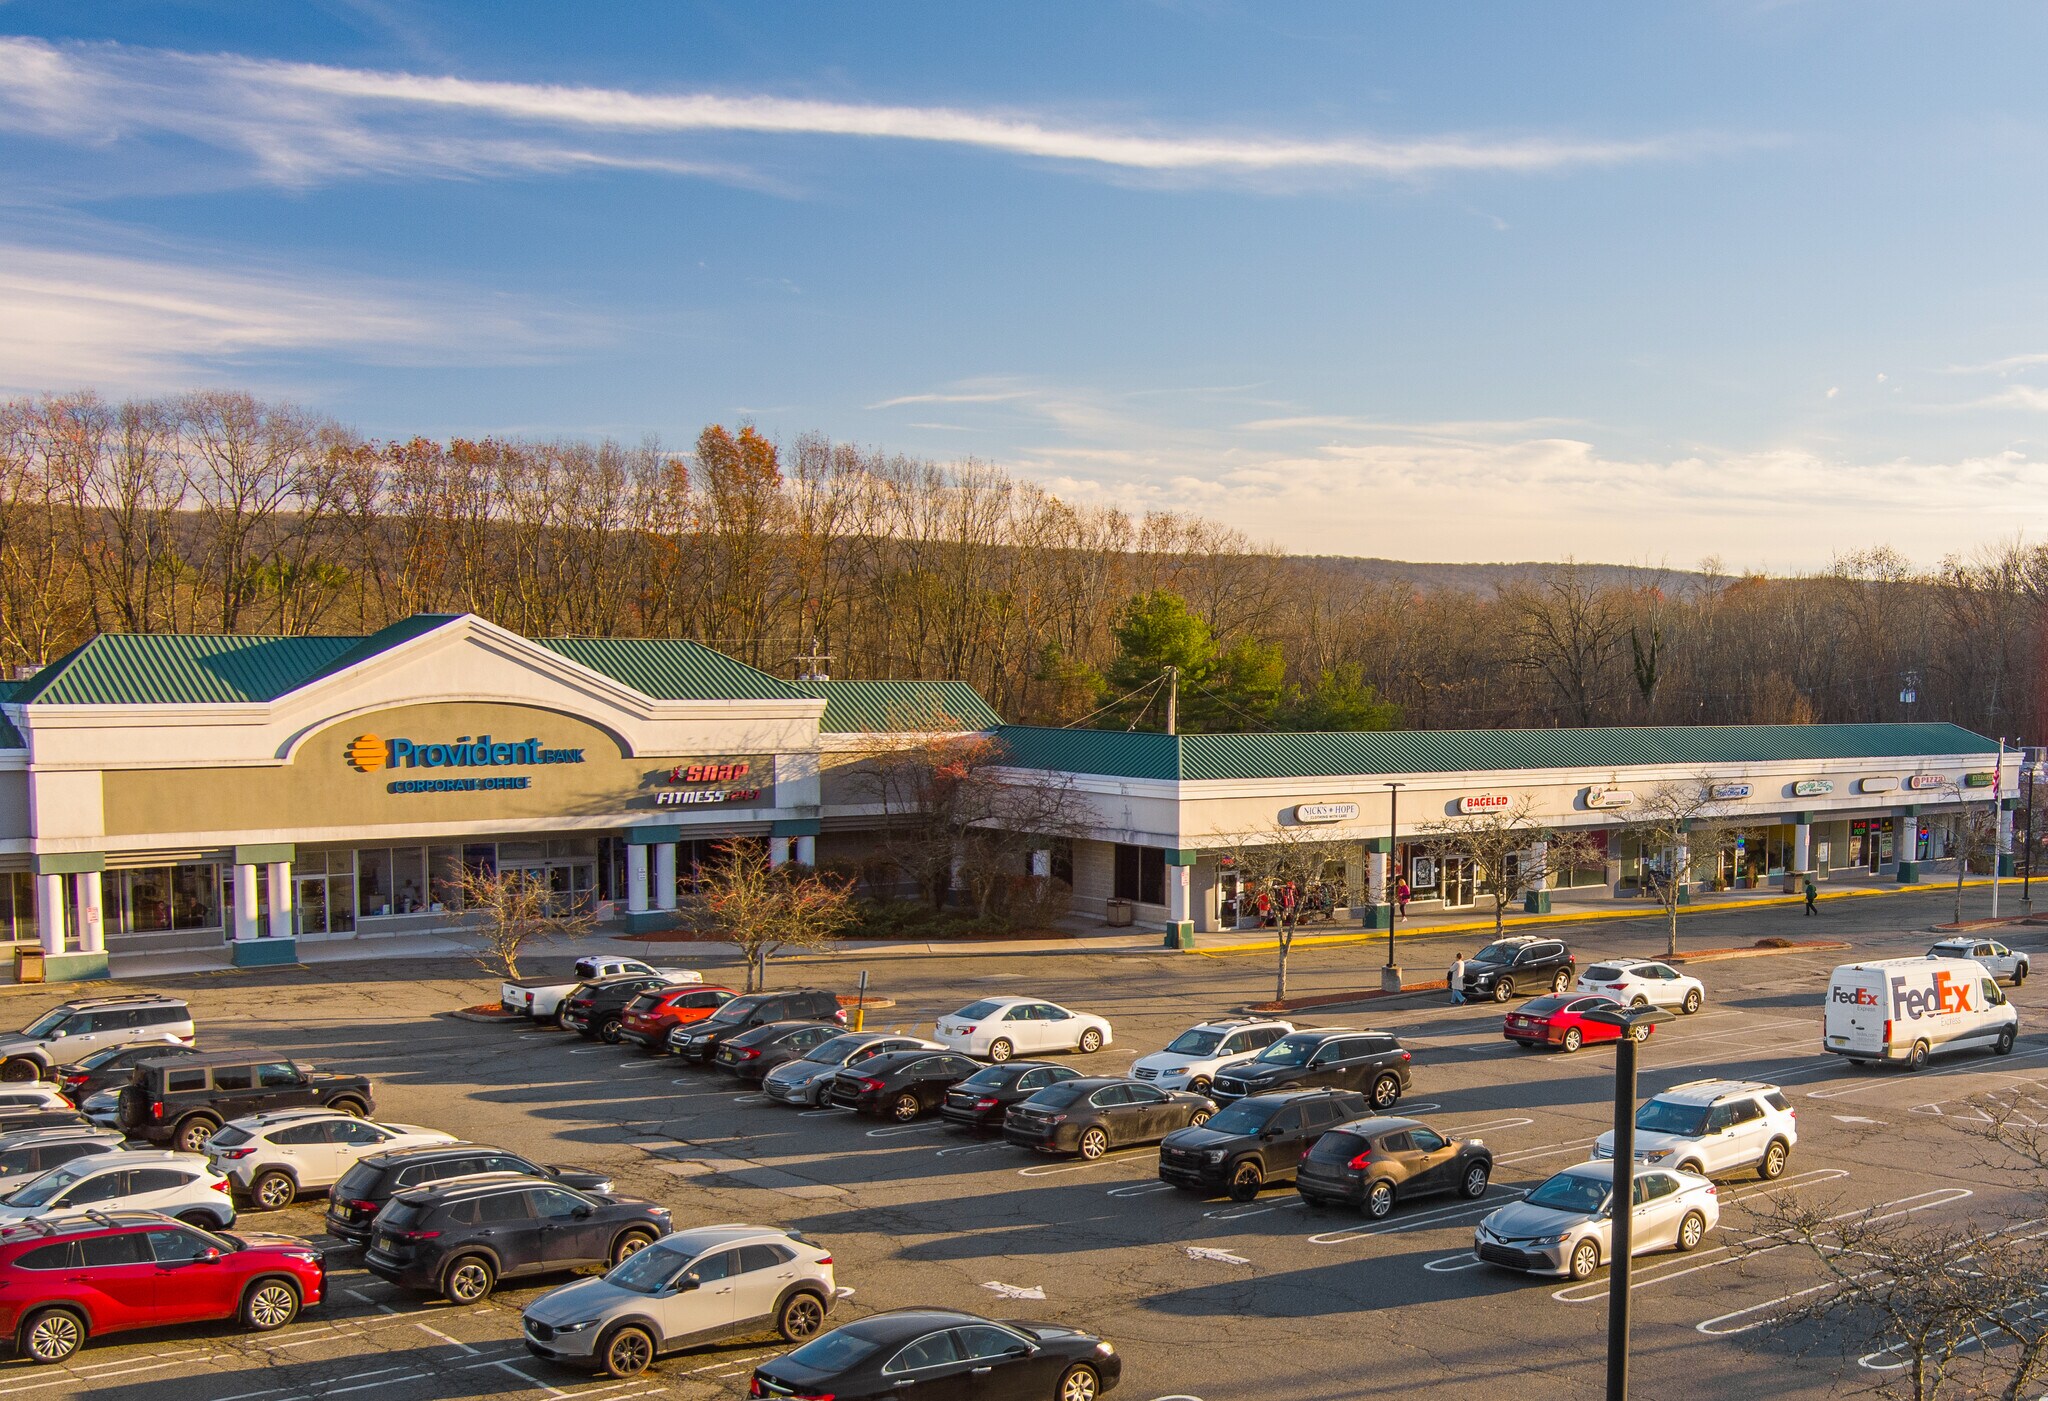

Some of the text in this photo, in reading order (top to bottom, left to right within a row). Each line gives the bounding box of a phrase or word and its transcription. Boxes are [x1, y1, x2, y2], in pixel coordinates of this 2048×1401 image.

[391, 735, 586, 768] Provident BANK
[393, 776, 532, 793] CORPORATE OFFICE
[656, 790, 726, 804] FITNESS
[1467, 796, 1508, 807] BAGELED
[1304, 804, 1355, 815] NICK'S HOPE
[1832, 986, 1879, 1006] FedEx
[1891, 971, 1973, 1021] FedEx
